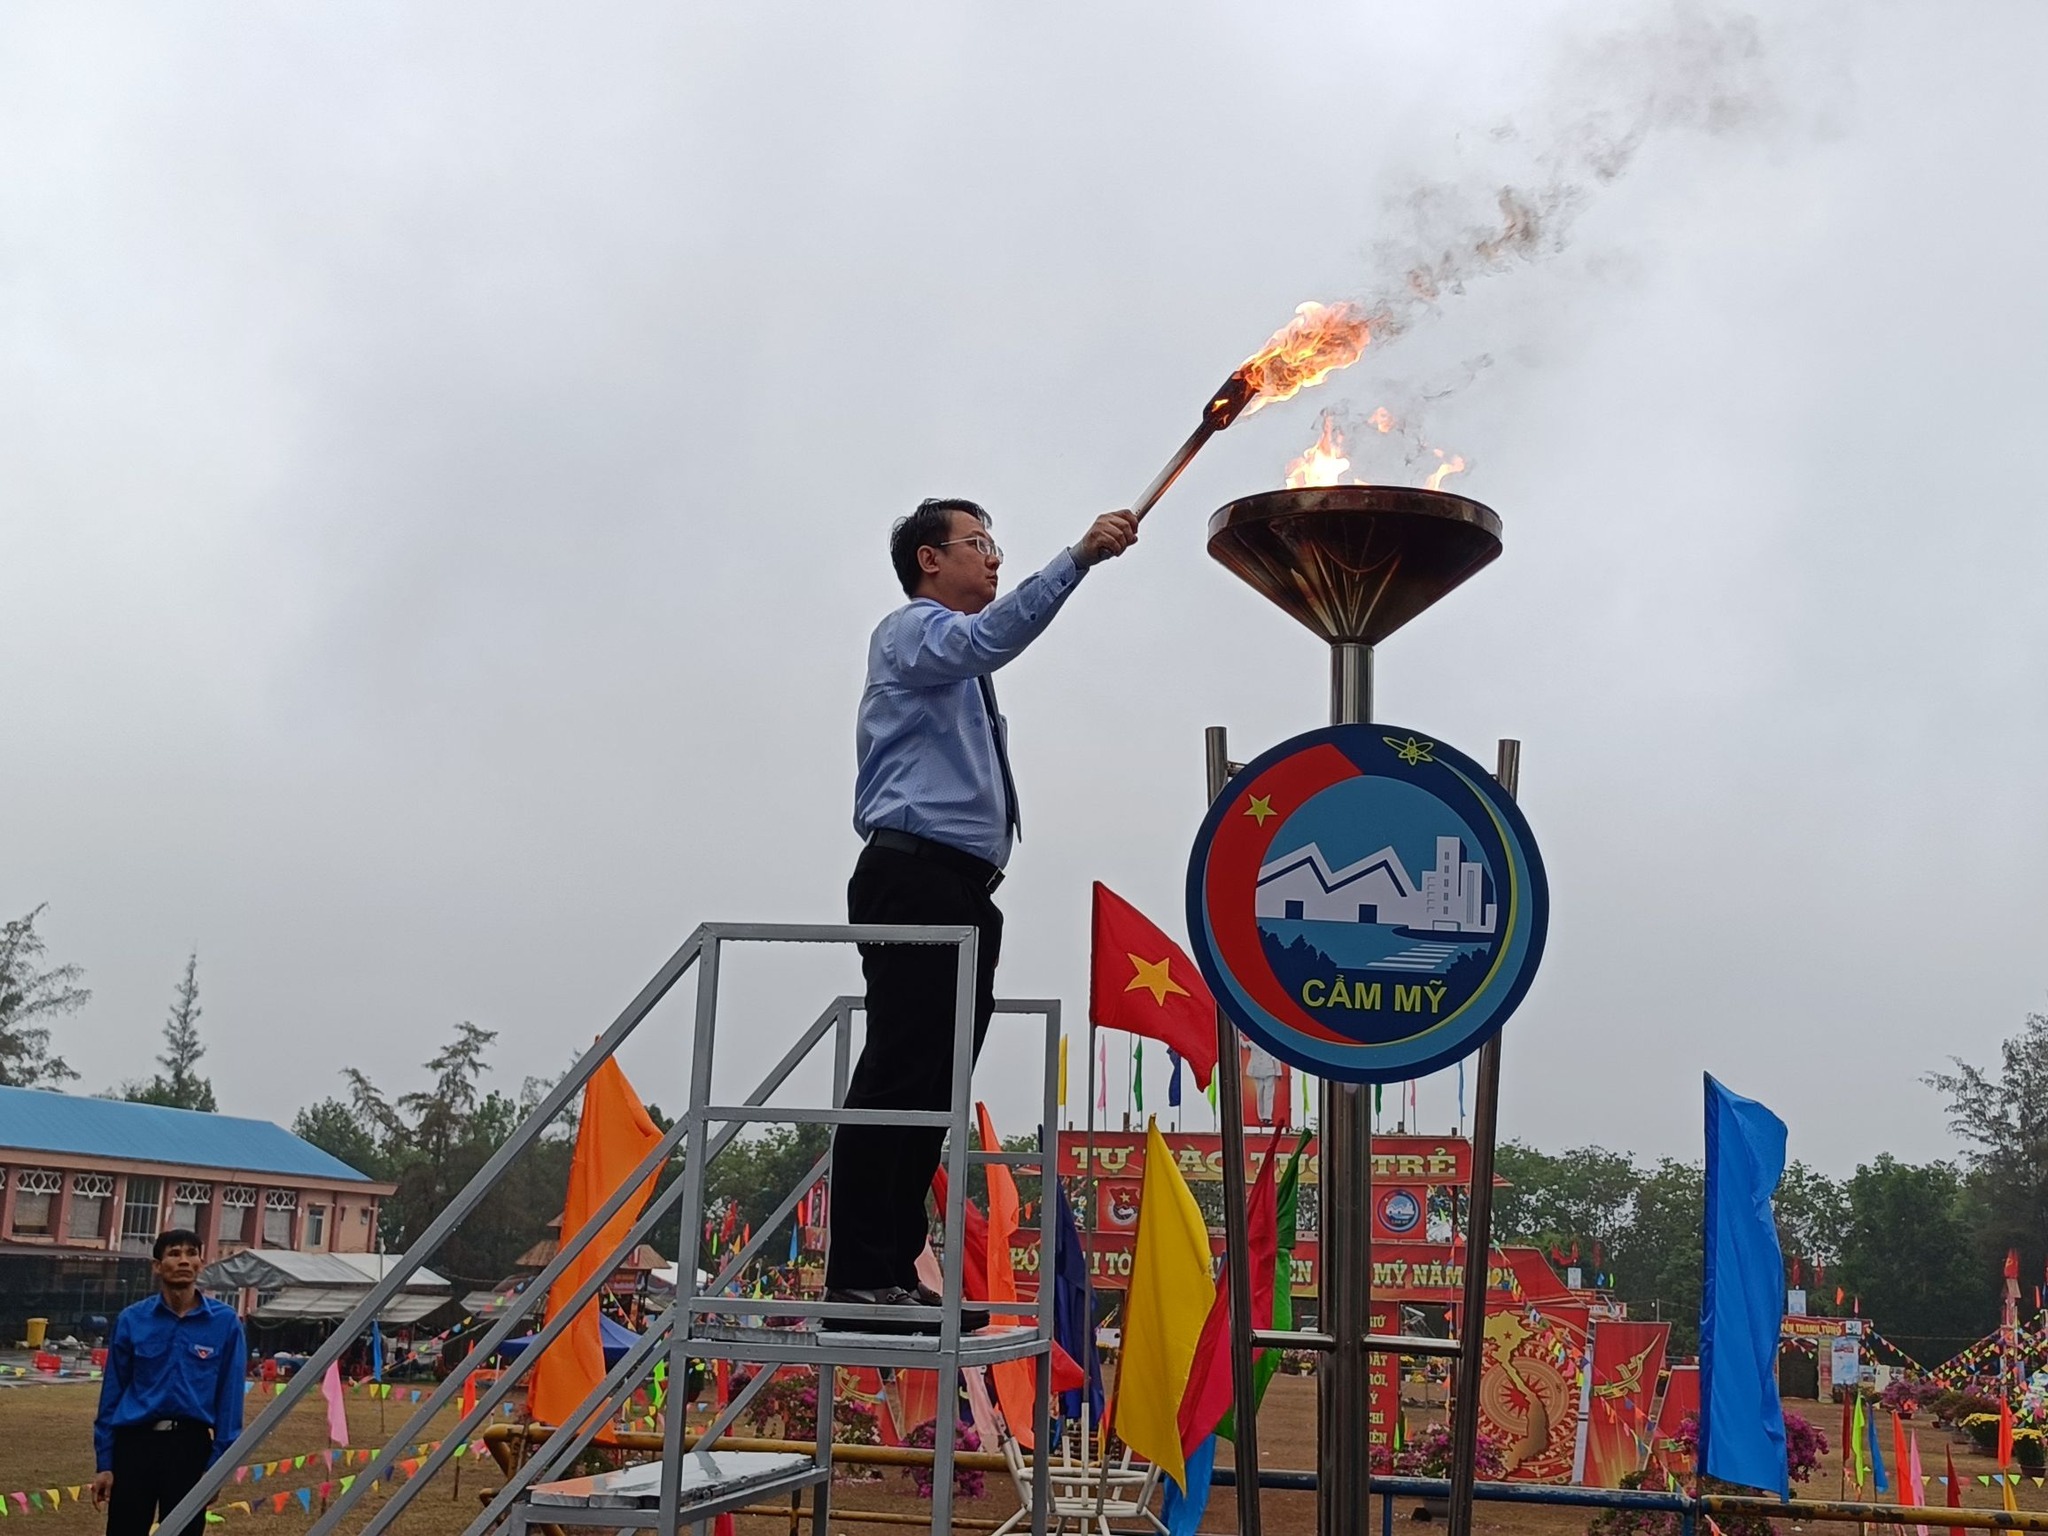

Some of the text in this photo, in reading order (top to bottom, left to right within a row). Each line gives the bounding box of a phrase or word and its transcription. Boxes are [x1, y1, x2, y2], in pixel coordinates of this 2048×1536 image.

[1302, 974, 1448, 1013] CẨM MỸ
[1071, 1146, 1134, 1174] TỰ
[1371, 1147, 1457, 1176] TRẺ
[1373, 1259, 1408, 1285] MỸ
[1412, 1260, 1464, 1286] NĂM
